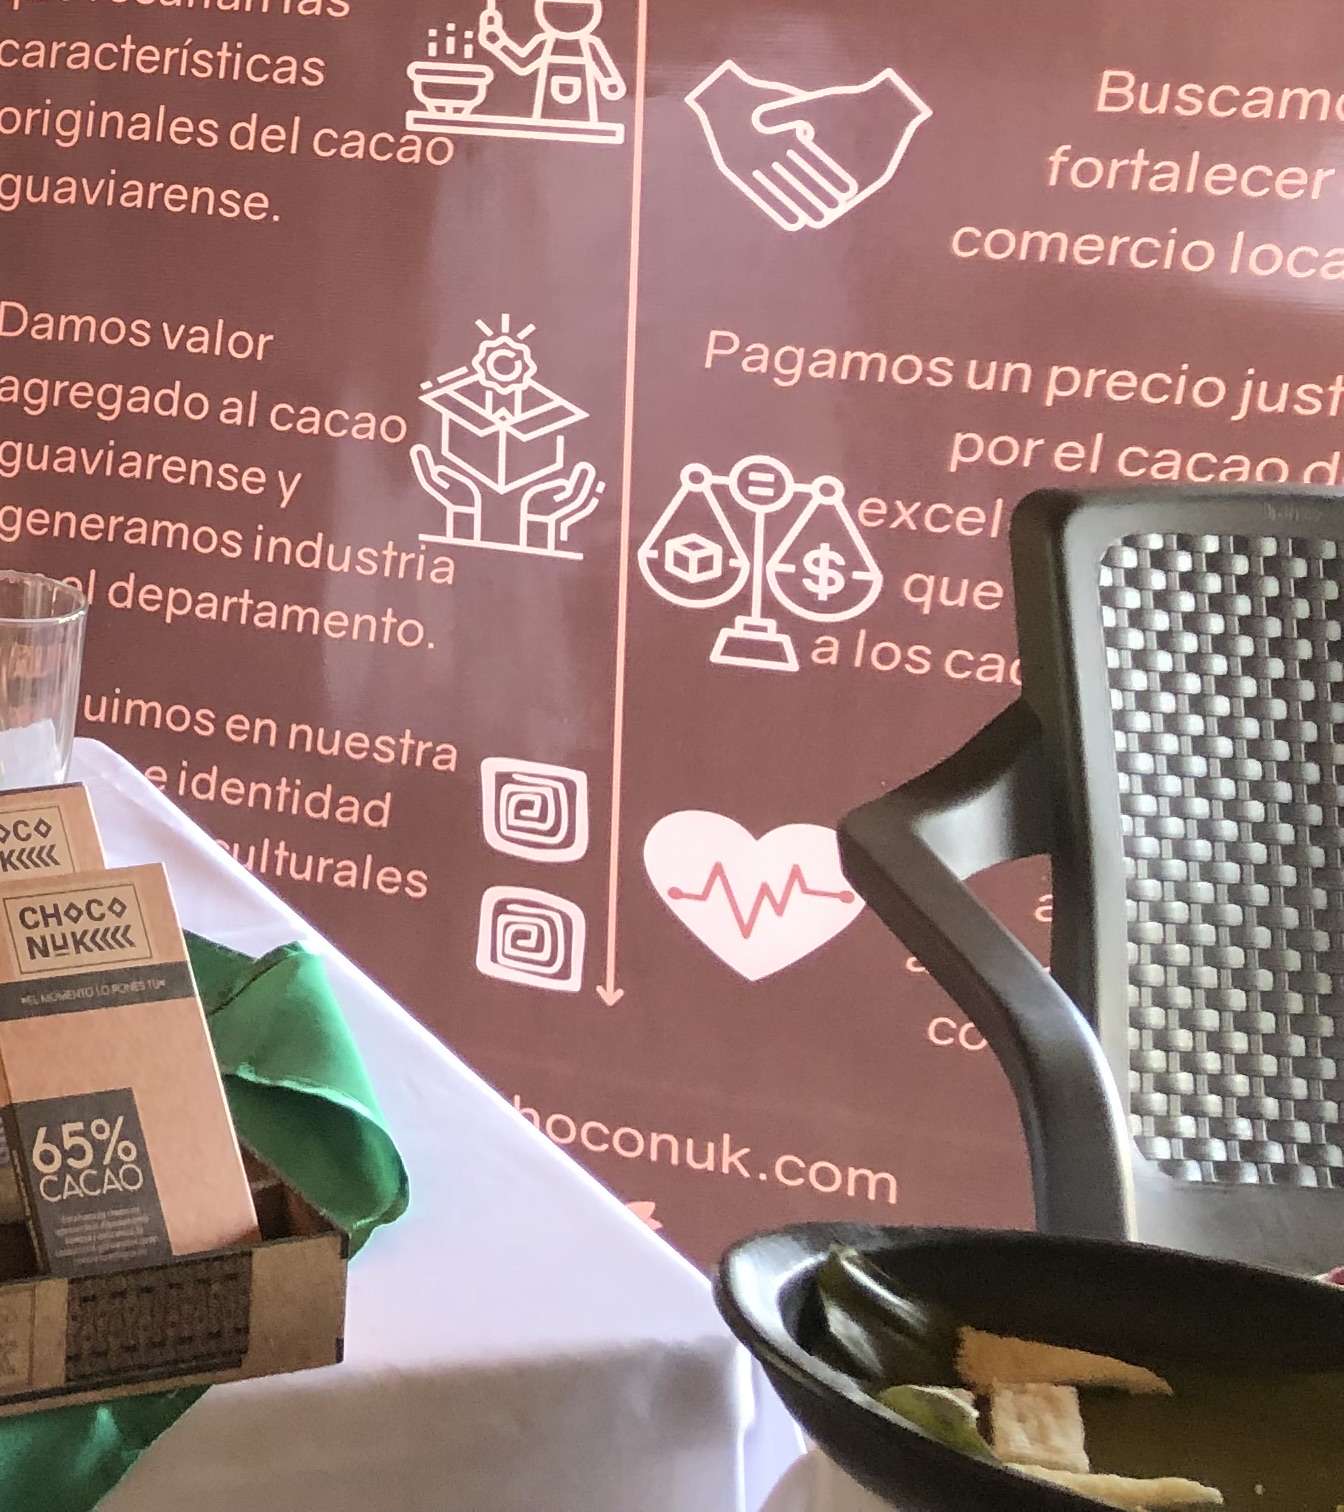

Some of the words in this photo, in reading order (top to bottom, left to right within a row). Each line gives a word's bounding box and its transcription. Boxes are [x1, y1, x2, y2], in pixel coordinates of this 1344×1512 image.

[1097, 69, 1344, 123] Buscam
[229, 112, 300, 154] del
[313, 126, 453, 166] cacao
[1046, 144, 1336, 200] fortalecer
[951, 224, 1215, 272] comercio
[162, 318, 273, 361] valor
[703, 328, 954, 386] Pagamos
[967, 356, 1032, 392] un
[1045, 363, 1225, 406] precio
[220, 390, 256, 428] al
[270, 403, 407, 444] cacao
[948, 429, 1045, 473] por
[1053, 432, 1103, 474] el
[1117, 443, 1288, 484] cacao
[277, 469, 302, 509] y
[253, 524, 455, 585] industria
[108, 571, 435, 649] departamento.
[903, 571, 1003, 615] que
[811, 634, 839, 664] a
[853, 629, 931, 675] los
[225, 713, 278, 748] en
[289, 719, 458, 772] nuestra
[179, 759, 391, 829] identidad
[215, 838, 429, 900] ulturales
[18, 897, 127, 930] CHOCO
[31, 1115, 137, 1176] 65%
[38, 1163, 144, 1204] CACAO
